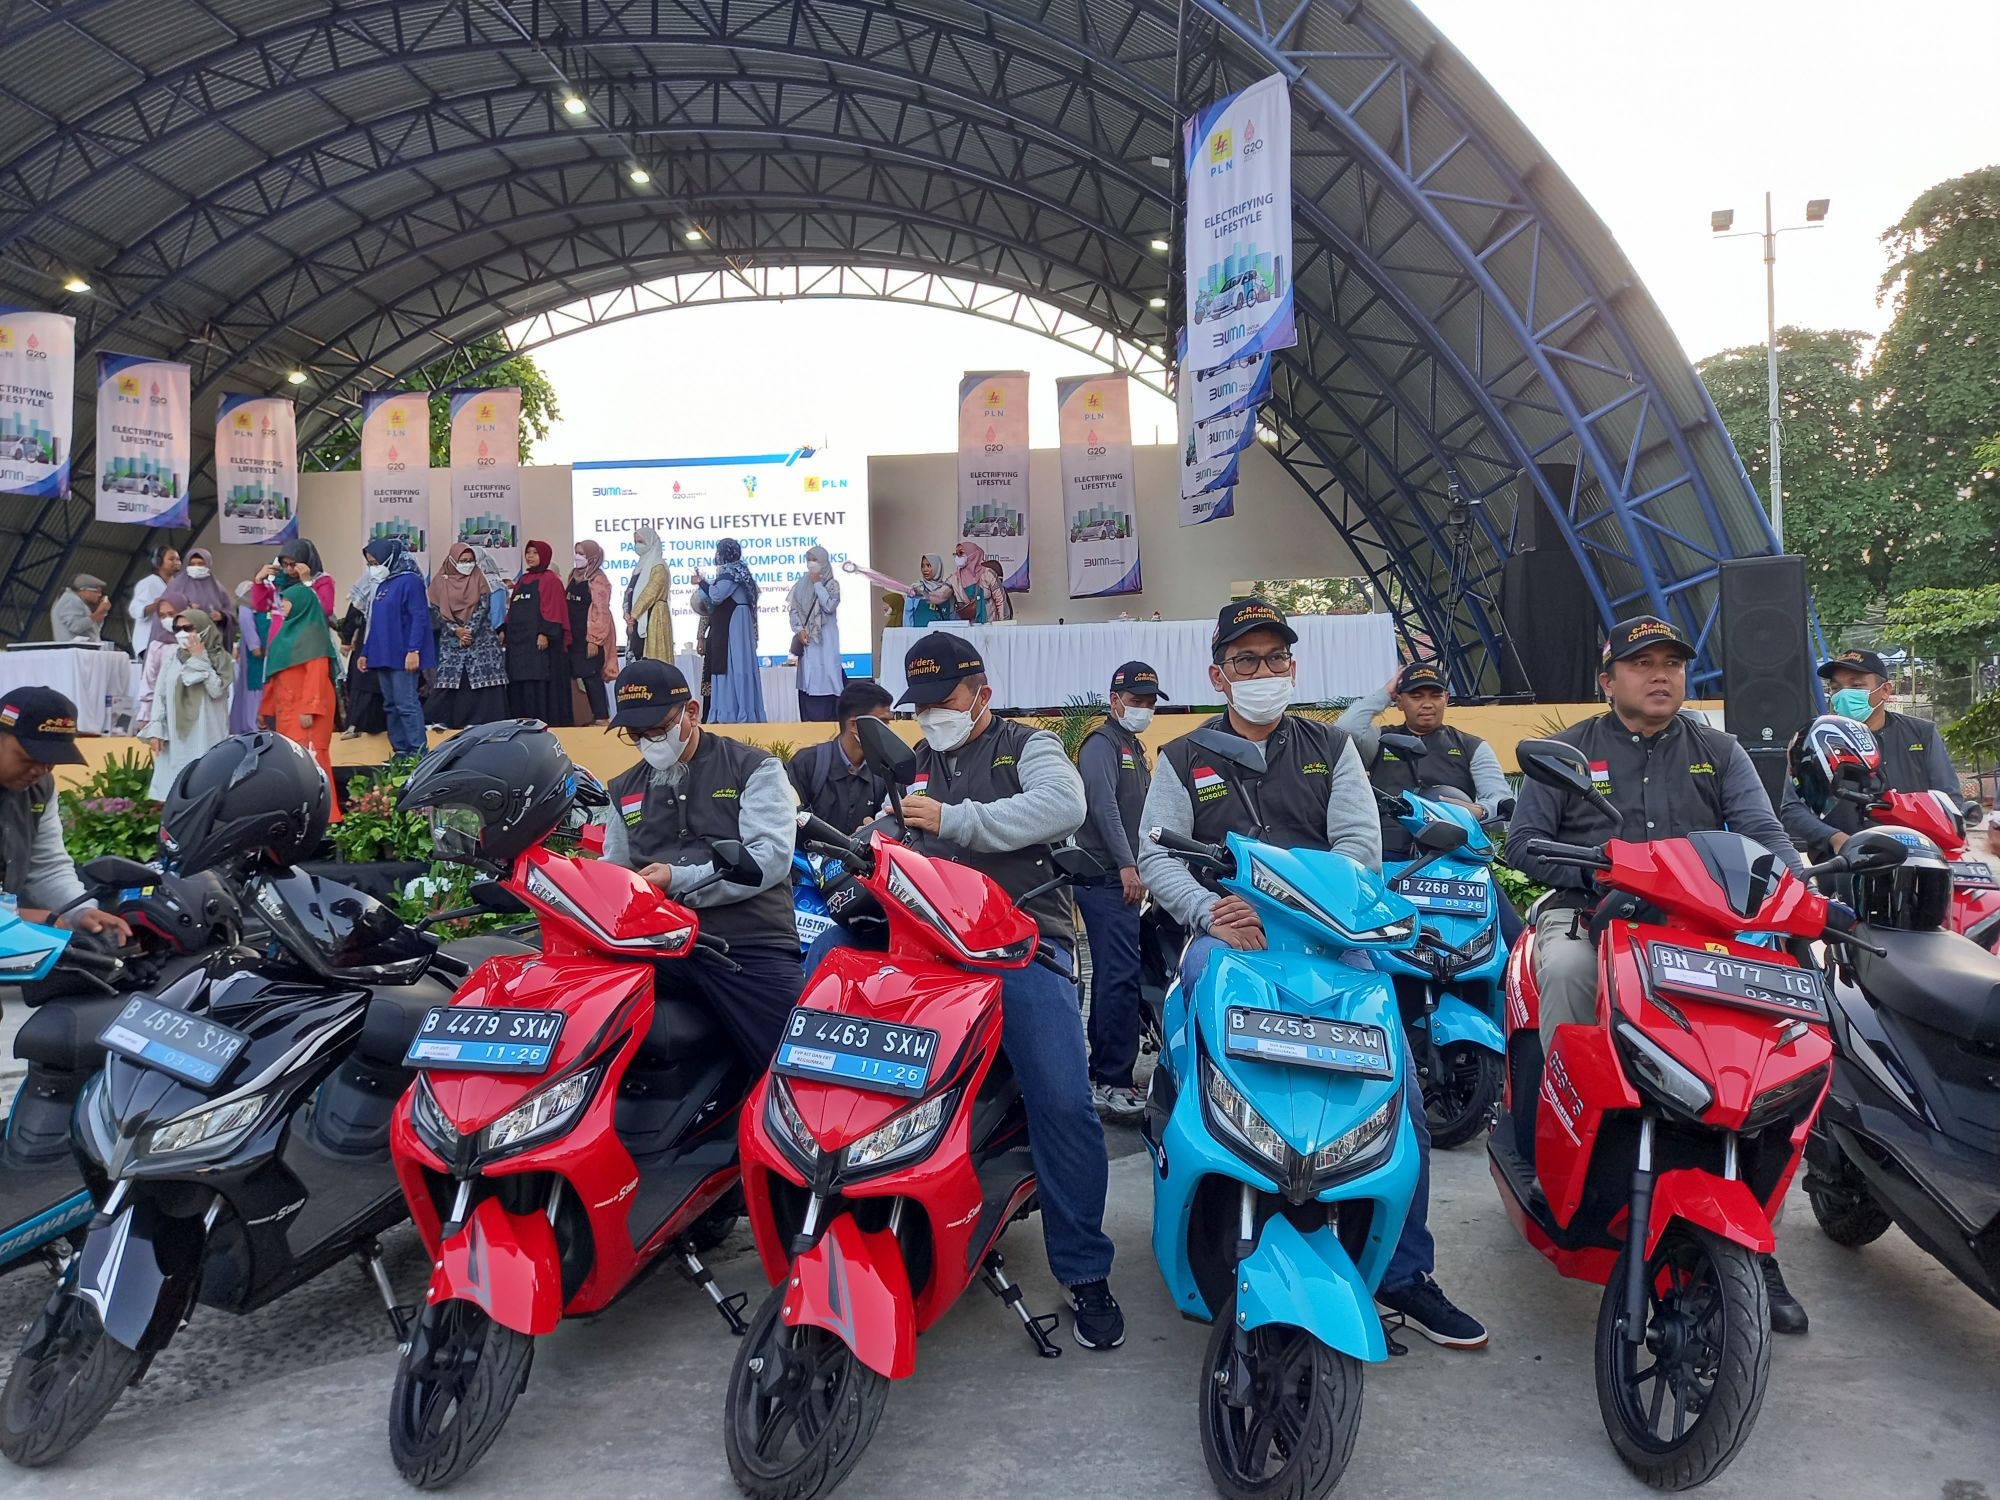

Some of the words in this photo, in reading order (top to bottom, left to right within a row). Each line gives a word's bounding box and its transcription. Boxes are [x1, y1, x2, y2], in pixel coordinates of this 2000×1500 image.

[1243, 139, 1263, 155] G20
[1210, 160, 1233, 177] PLN
[1205, 192, 1273, 229] ELECTRIFYING
[1213, 210, 1262, 239] LIFESTYLE
[26, 349, 47, 359] G20
[119, 396, 139, 404] PLN
[1085, 412, 1104, 420] PLN
[112, 425, 173, 441] ELECTRIFYING
[476, 424, 496, 432] PLN
[120, 436, 165, 448] LIFESTYLE
[984, 444, 1004, 452] G20
[1087, 447, 1106, 456] G20
[230, 457, 283, 468] ELECTRIFYING
[387, 462, 405, 471] G20
[477, 457, 496, 466] G20
[238, 466, 278, 475] LIFESTYLE
[821, 479, 848, 488] PLN
[1074, 473, 1123, 483] ELECTRIFYING
[463, 484, 511, 492] ELECTRIFYING
[1081, 481, 1117, 491] LIFESTYLE
[595, 516, 705, 532] ELECTRIFYING
[710, 513, 788, 529] LIFESTYLE
[793, 511, 846, 526] EVENT
[740, 538, 772, 549] OTOR
[1233, 612, 1280, 624] Community
[1197, 783, 1227, 796] SUMKAL
[1199, 789, 1228, 802] BOSQUE
[1402, 880, 1410, 890] B
[1416, 882, 1449, 894] 4268
[1458, 885, 1484, 897] SXU
[797, 917, 834, 931] LISTRI
[1660, 950, 1689, 969] BN
[1703, 961, 1762, 982] 4077
[1781, 974, 1811, 994] TG
[122, 1000, 142, 1019] B
[143, 1009, 194, 1039] 4675
[423, 1013, 440, 1033] B
[446, 1014, 500, 1035] 4479
[509, 1017, 556, 1039] SXW
[1232, 1013, 1245, 1029] B
[1258, 1017, 1316, 1039] 4453
[1330, 1027, 1378, 1049] SXW
[790, 1015, 807, 1037] B
[815, 1021, 870, 1048] 4463
[883, 1031, 931, 1059] SXW
